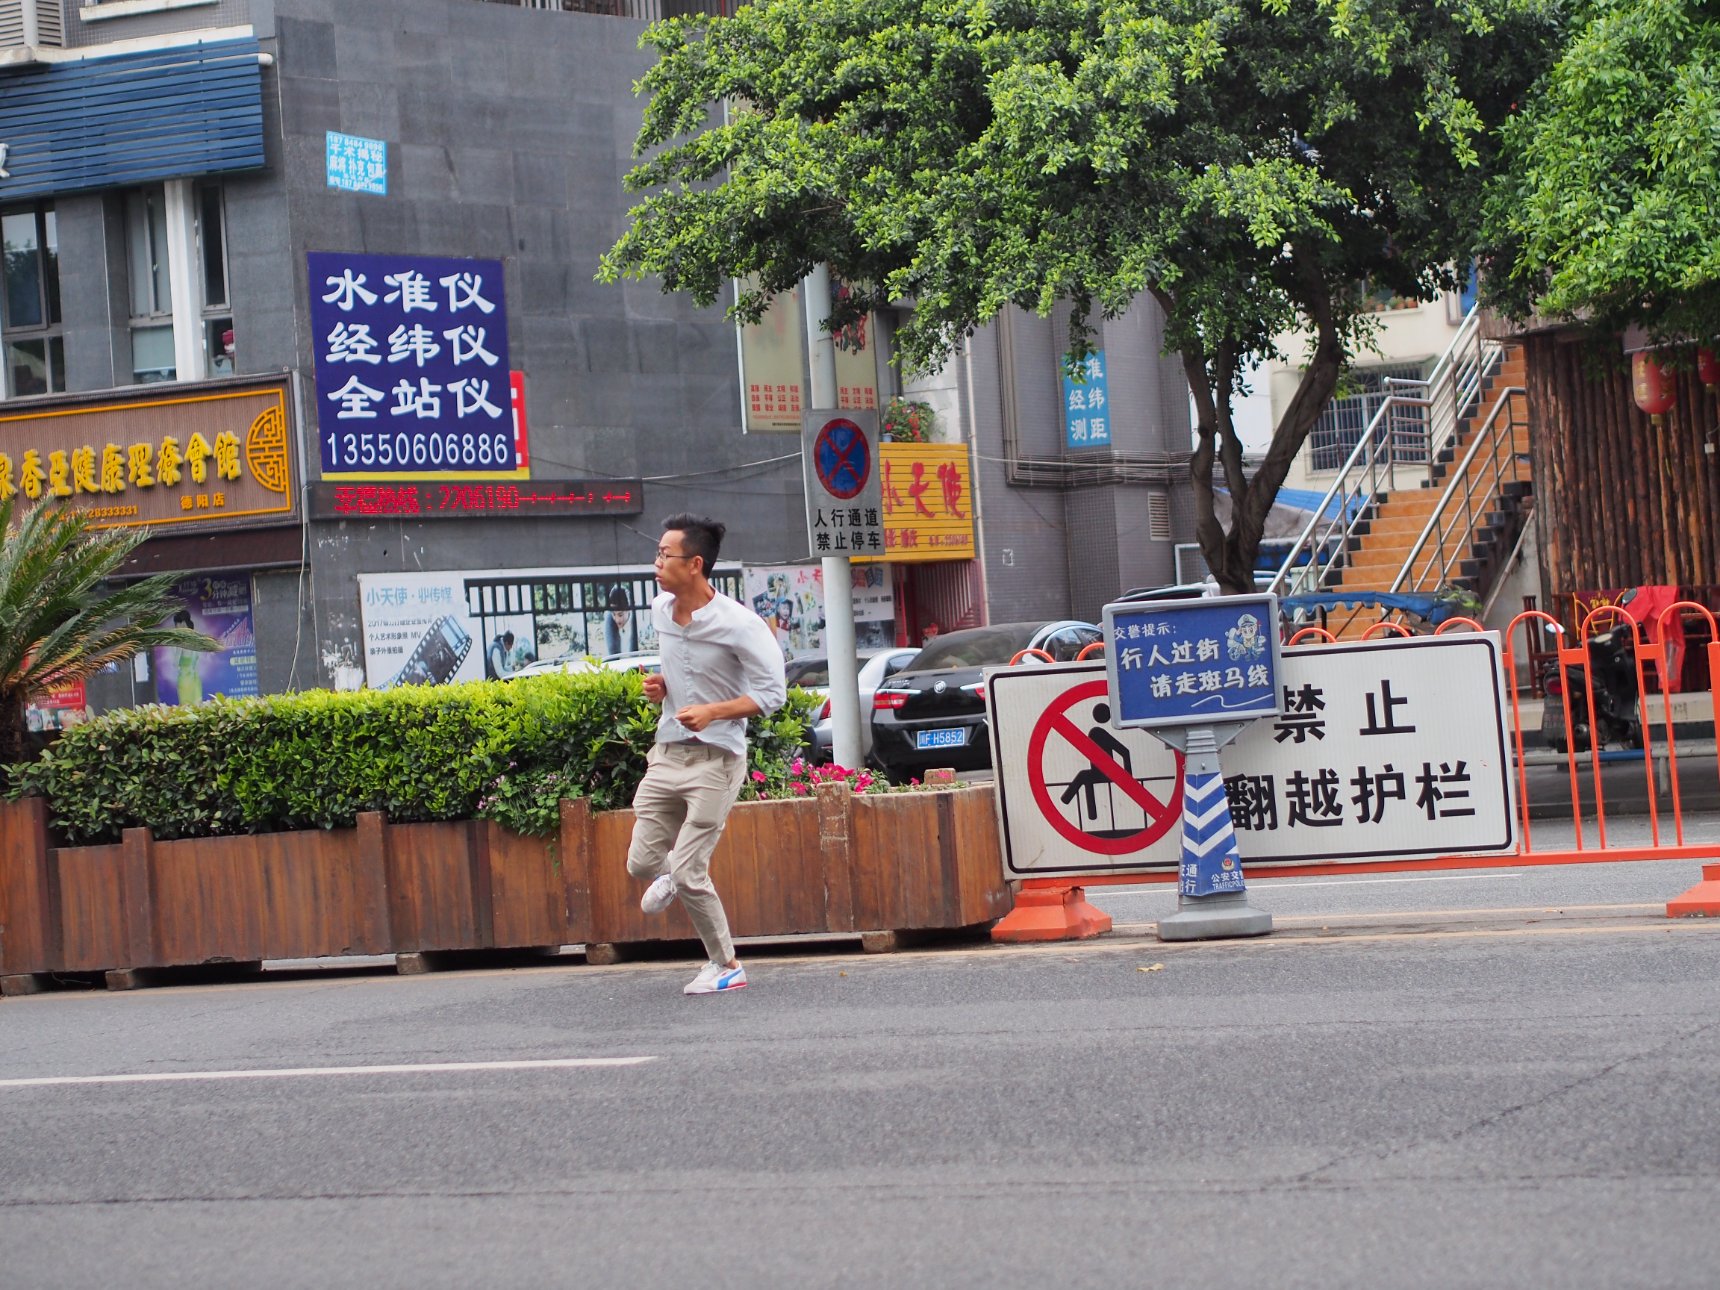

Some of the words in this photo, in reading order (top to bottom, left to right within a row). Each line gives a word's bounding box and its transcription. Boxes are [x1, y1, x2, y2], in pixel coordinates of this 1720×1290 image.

[321, 268, 496, 315] 水准仪
[325, 321, 499, 368] 经纬仪
[327, 375, 503, 419] 全站仪
[1069, 387, 1105, 410] 经纬
[1070, 418, 1107, 441] 测距
[327, 432, 508, 465] 13550606886
[181, 492, 225, 510] 德阳店
[880, 459, 965, 519] 小天使
[814, 508, 879, 528] 人行通道
[816, 530, 881, 551] 禁止停车
[1120, 638, 1219, 670] 行人过街
[1150, 664, 1269, 698] 请走斑马线
[1273, 679, 1416, 744] 禁止
[1223, 760, 1476, 831] 翻越护栏
